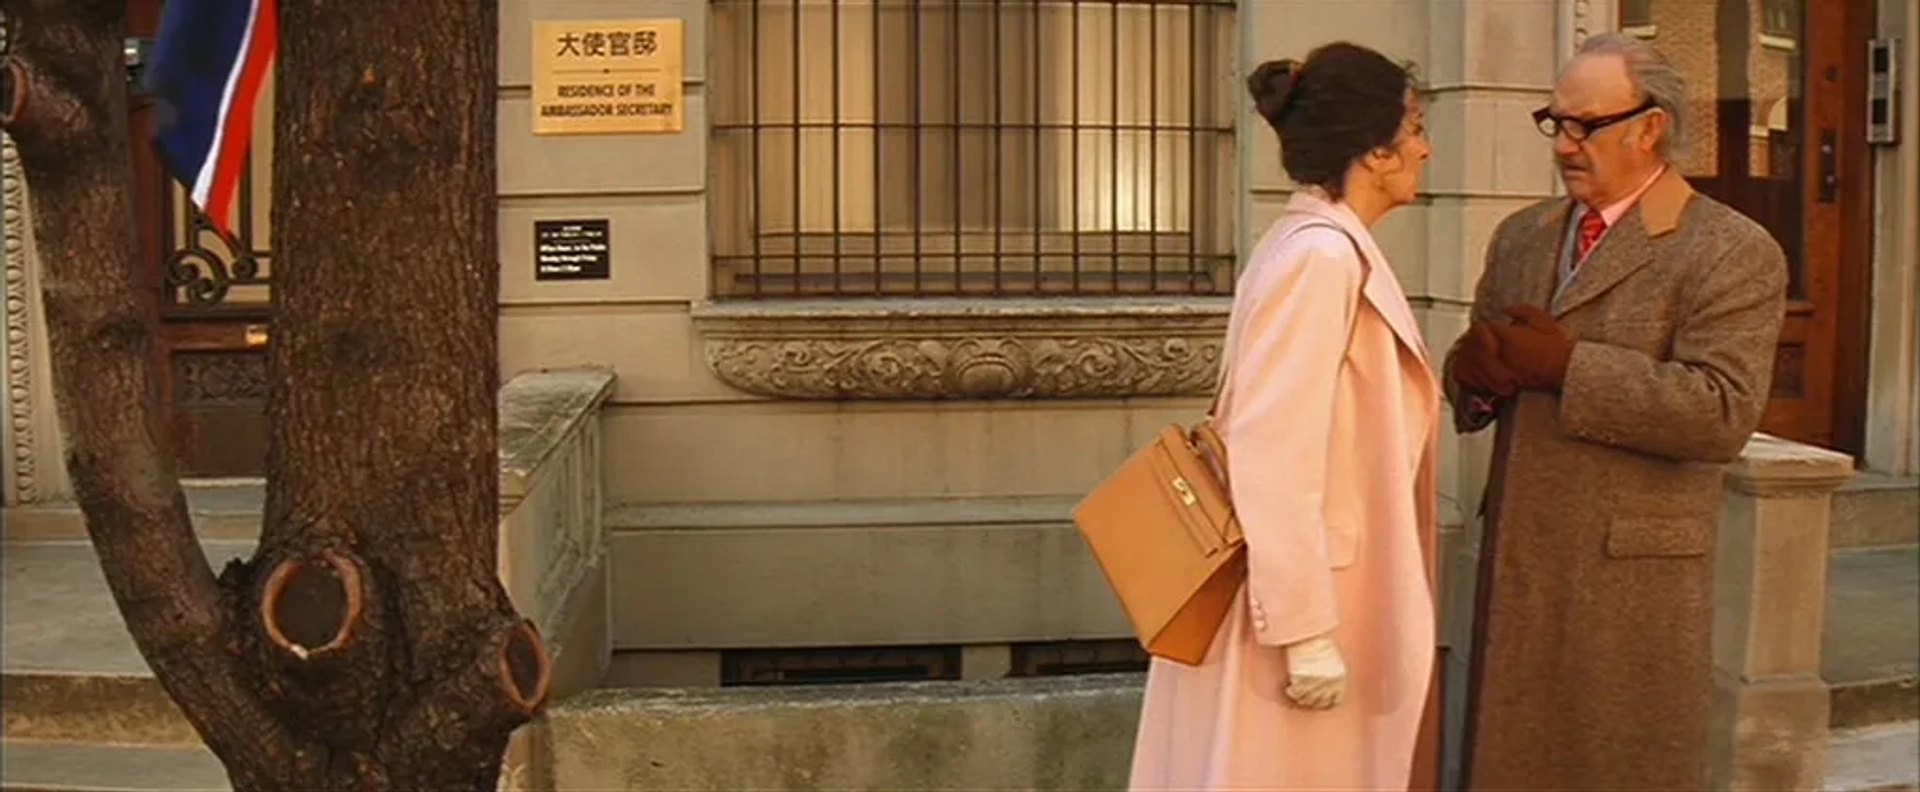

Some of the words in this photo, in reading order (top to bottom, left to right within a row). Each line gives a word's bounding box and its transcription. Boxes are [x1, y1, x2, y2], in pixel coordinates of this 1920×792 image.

[557, 31, 657, 57] 大使官邸
[558, 84, 614, 97] RESIDENCE
[617, 84, 631, 96] OF
[635, 83, 655, 96] THE
[541, 104, 613, 116] AMBASSADOR
[617, 103, 673, 115] SECRETARY
